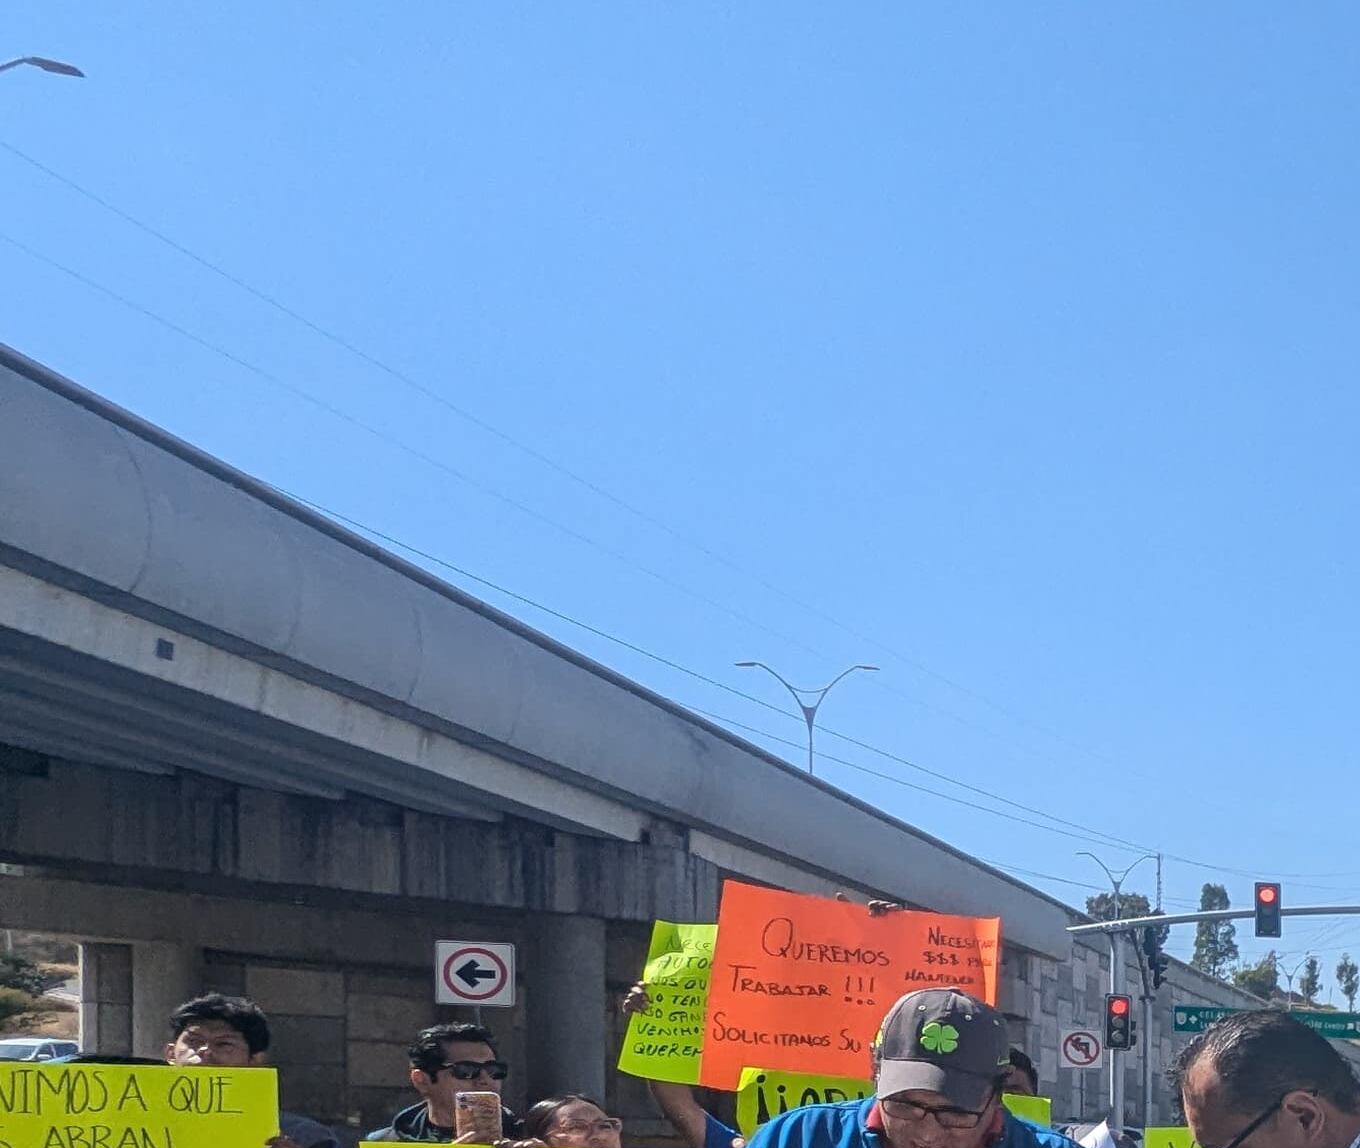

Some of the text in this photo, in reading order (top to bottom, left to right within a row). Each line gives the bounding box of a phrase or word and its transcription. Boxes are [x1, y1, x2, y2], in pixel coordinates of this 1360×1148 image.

[762, 917, 890, 967] QUEREMOS
[118, 1074, 148, 1111] A
[169, 1075, 243, 1115] QUE
